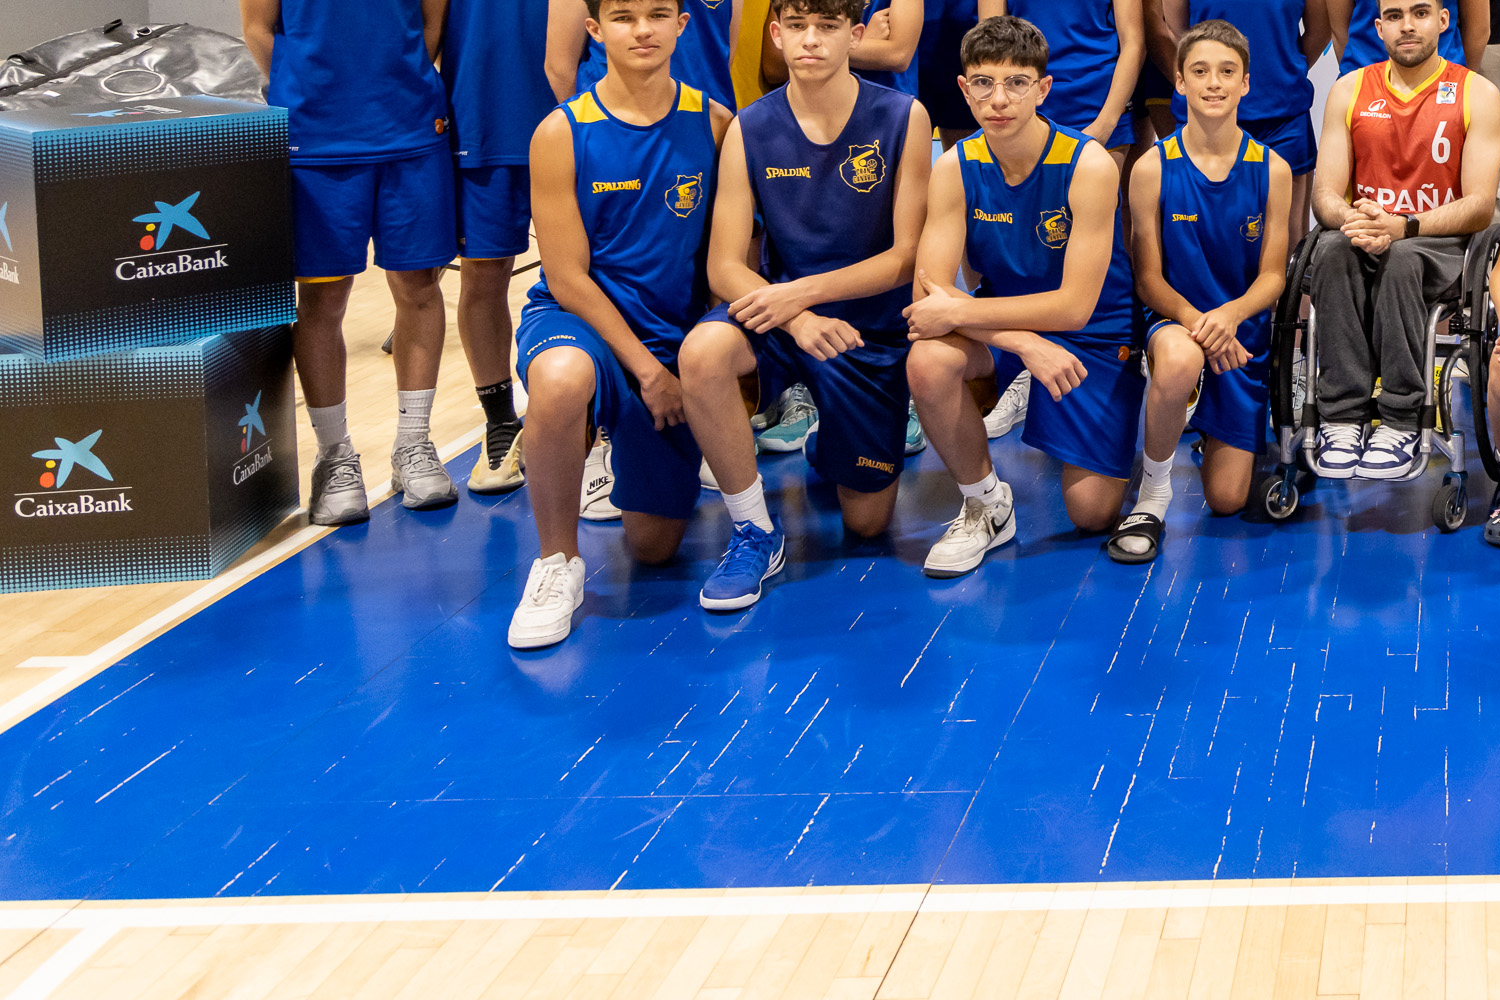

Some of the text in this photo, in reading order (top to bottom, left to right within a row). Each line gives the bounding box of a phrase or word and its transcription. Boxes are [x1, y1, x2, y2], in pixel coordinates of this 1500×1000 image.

[1360, 111, 1391, 119] DECATHLON
[1431, 121, 1451, 164] 6
[767, 167, 812, 180] SPALDING
[593, 179, 641, 194] SPALDING
[974, 208, 1013, 224] SPALDING
[1172, 214, 1198, 222] SPALDING
[0, 261, 20, 285] aBank
[115, 249, 229, 281] CaixaBank
[233, 446, 273, 486] CaixaBank
[856, 456, 895, 474] SPALDING
[589, 475, 609, 489] NIKE
[14, 493, 134, 518] CaixaBank
[1124, 514, 1149, 525] NIKE
